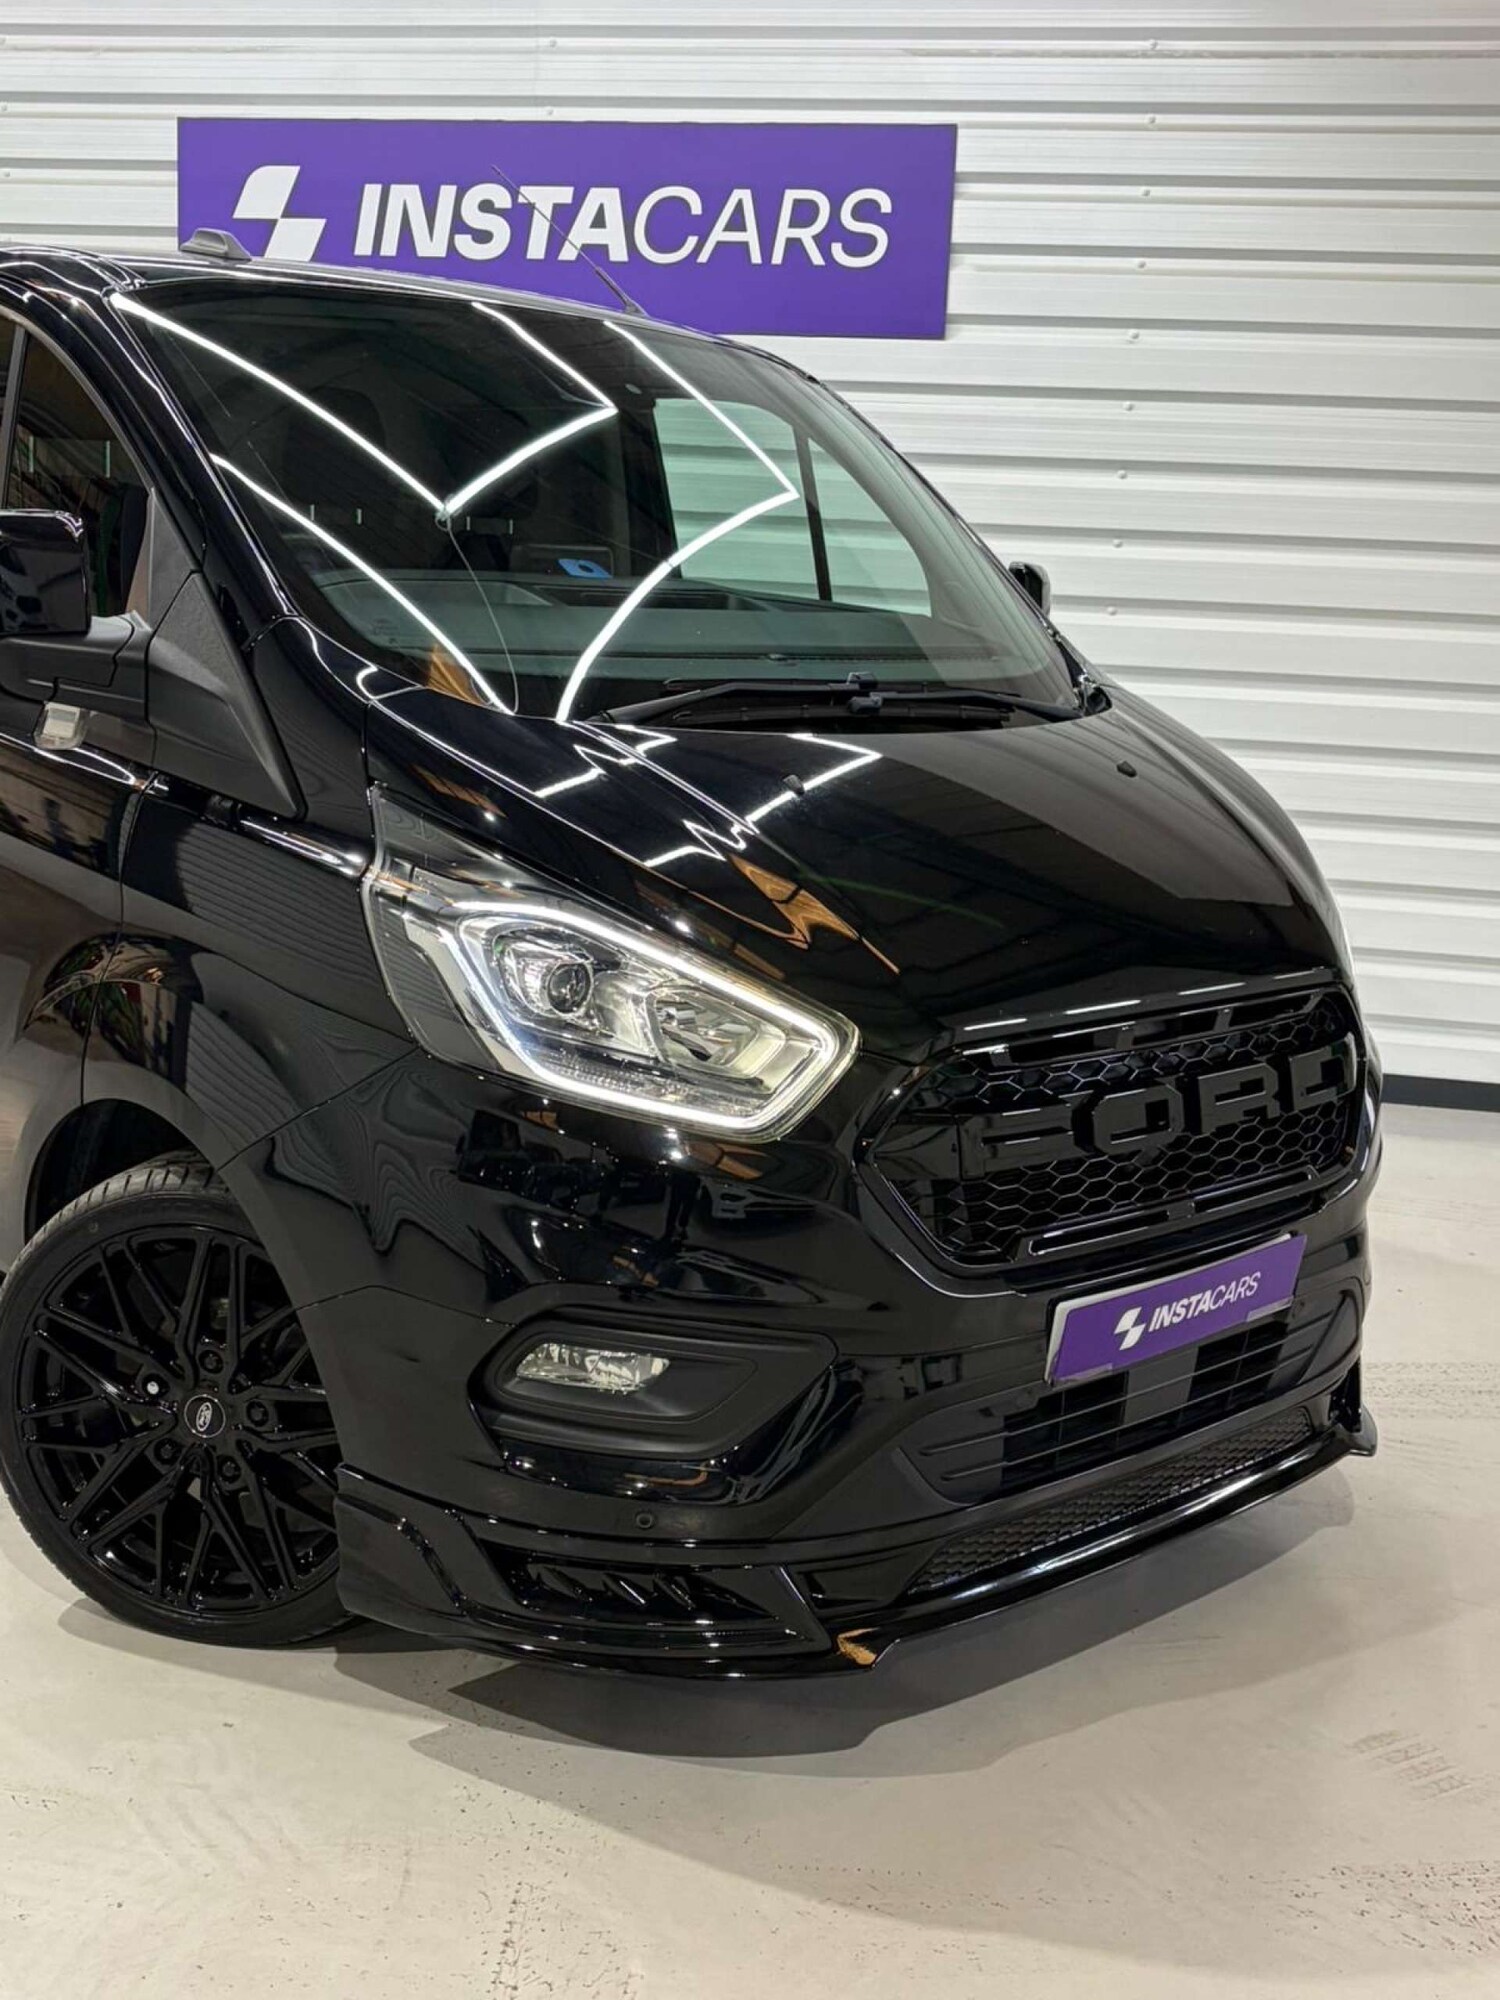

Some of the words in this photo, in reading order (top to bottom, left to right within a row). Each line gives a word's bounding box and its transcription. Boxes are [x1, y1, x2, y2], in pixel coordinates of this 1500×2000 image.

[353, 182, 893, 269] INSTACARS
[958, 1032, 1358, 1181] FORD
[1148, 1271, 1262, 1333] INSTACARS
